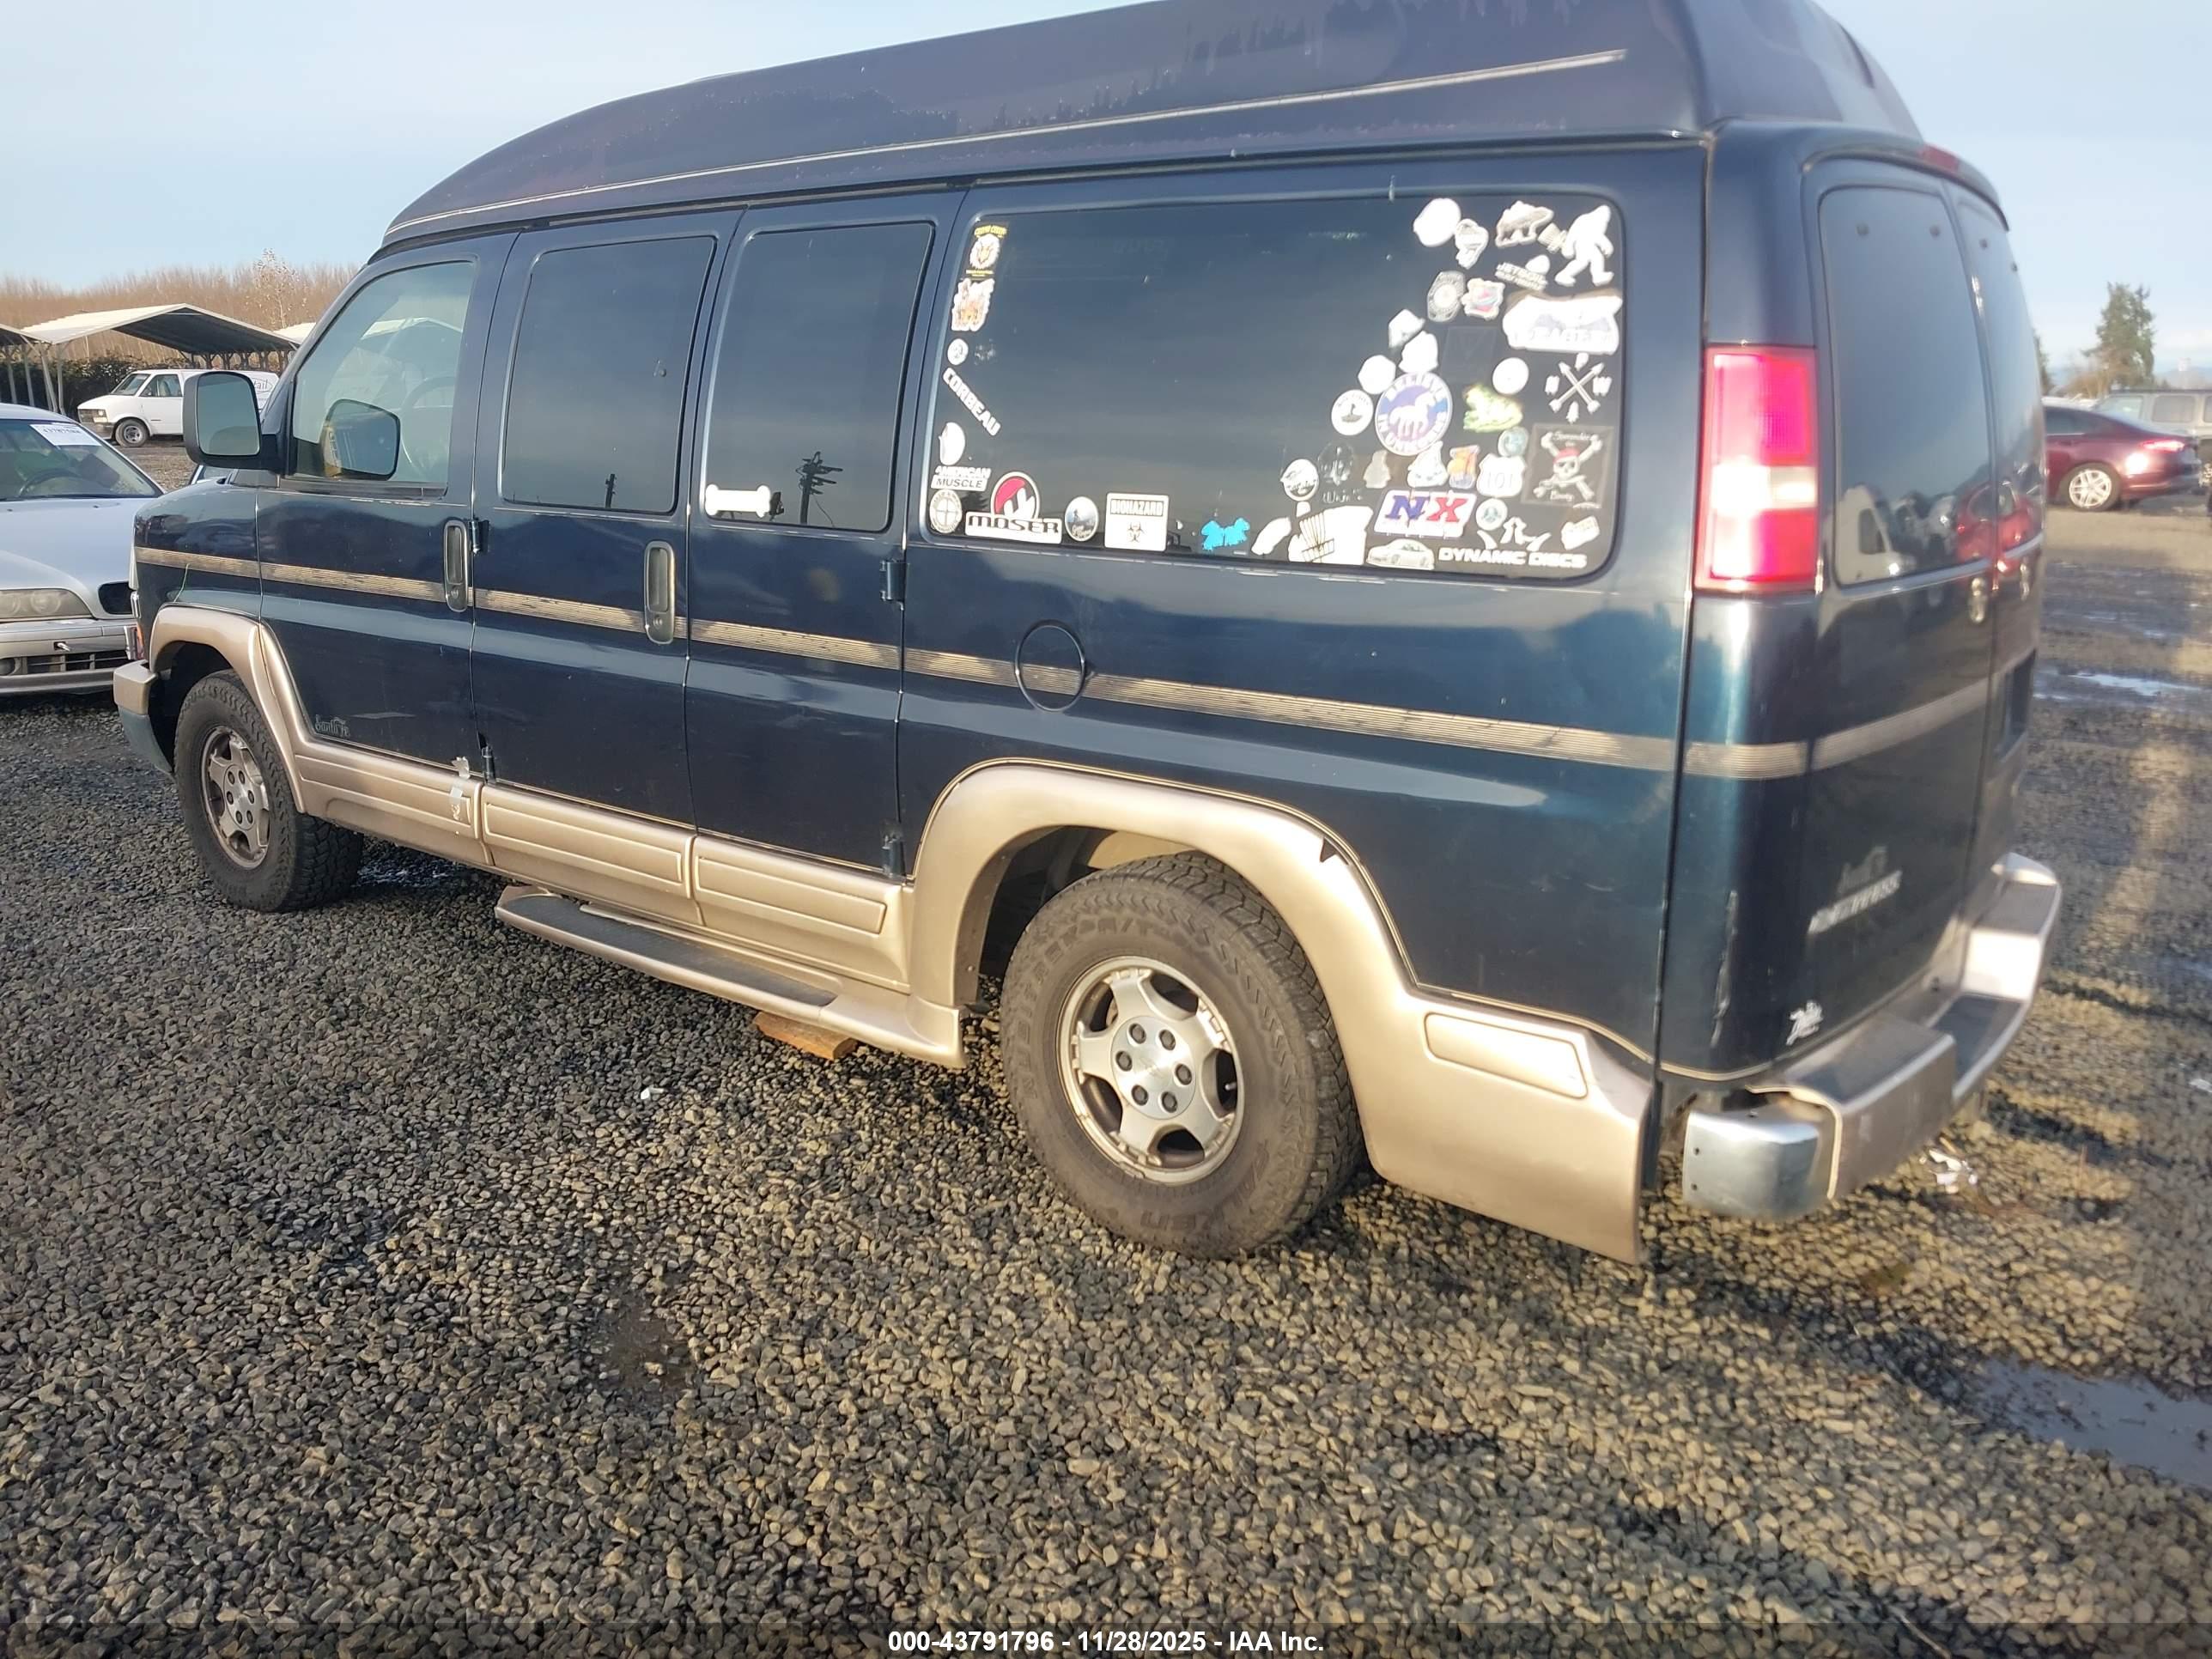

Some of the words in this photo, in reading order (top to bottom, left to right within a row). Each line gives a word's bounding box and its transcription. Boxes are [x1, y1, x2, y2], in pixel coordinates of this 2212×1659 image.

[943, 368, 1001, 436] CORBEAU
[936, 477, 983, 489] MUSCLE
[1486, 471, 1513, 489] 101
[1110, 499, 1164, 516] BIOHAZARD
[968, 514, 1059, 534] MOSER
[1437, 547, 1527, 566] DYNAMIC
[1528, 552, 1587, 568] DISCS
